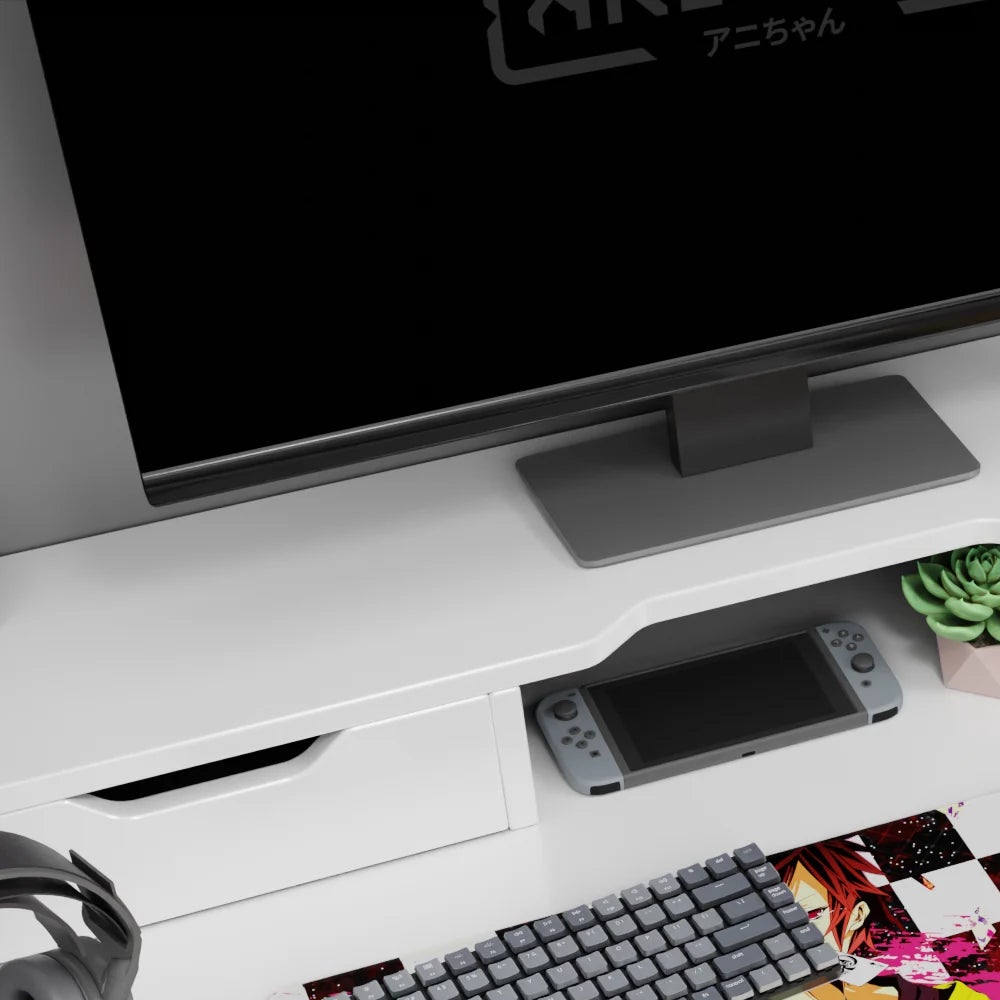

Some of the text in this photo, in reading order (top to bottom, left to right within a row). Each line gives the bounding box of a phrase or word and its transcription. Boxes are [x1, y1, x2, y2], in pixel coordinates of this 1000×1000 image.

[702, 7, 846, 58] アニちゃん
[725, 978, 745, 989] control
